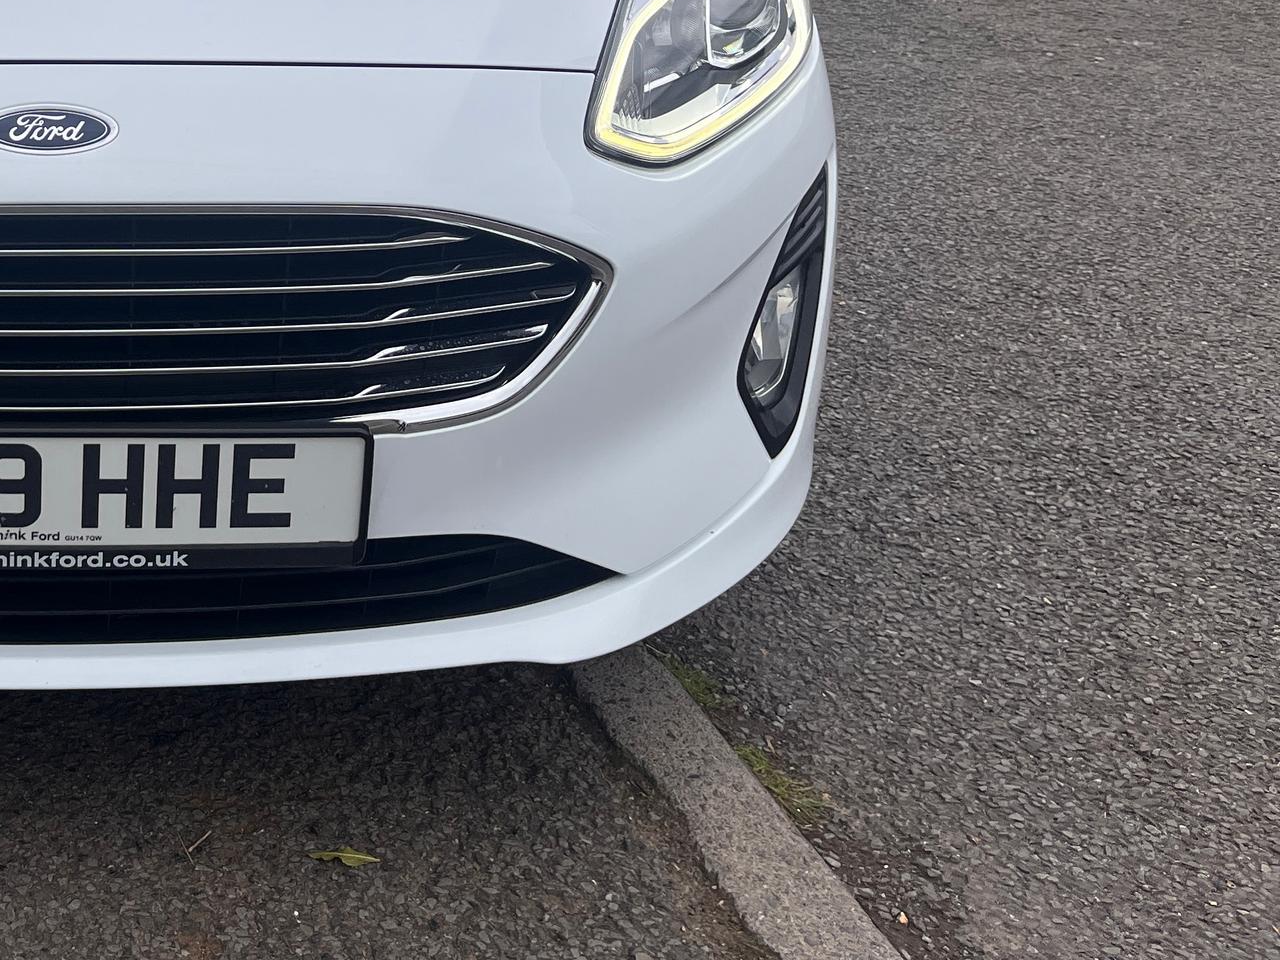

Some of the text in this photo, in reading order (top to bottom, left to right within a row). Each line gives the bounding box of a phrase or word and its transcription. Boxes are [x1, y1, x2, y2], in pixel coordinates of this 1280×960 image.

[9, 113, 86, 141] Ford
[81, 443, 296, 528] HHE
[31, 531, 60, 541] Ford
